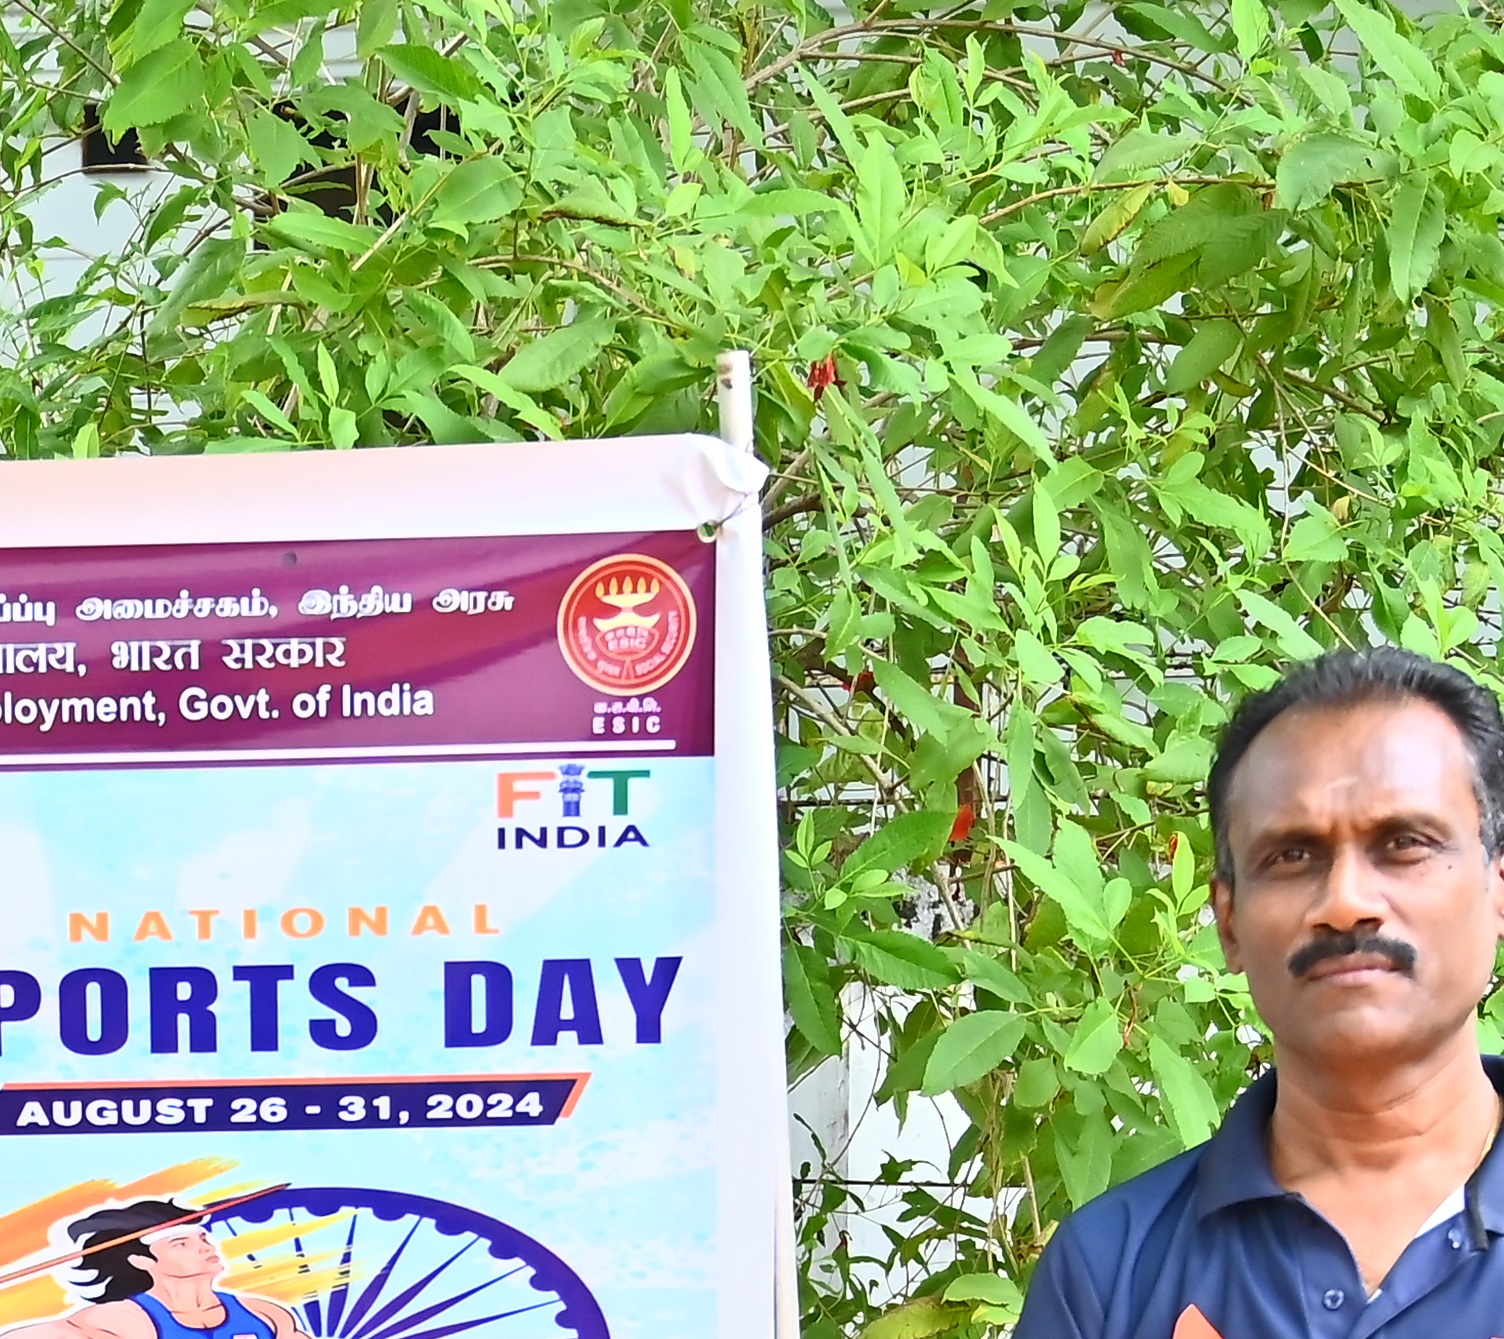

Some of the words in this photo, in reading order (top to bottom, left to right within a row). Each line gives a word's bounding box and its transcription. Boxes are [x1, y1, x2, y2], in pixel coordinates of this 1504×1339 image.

[299, 586, 411, 619] இந்திய
[433, 589, 514, 614] அரசு
[112, 640, 200, 670] भारत
[223, 638, 345, 668] सरकार
[180, 688, 278, 720] Govt.
[293, 685, 331, 717] of
[343, 684, 433, 716] India
[498, 825, 649, 849] INDIA
[70, 905, 497, 941] NATIONAL
[444, 956, 683, 1048] DAY
[17, 1099, 213, 1126] AUGUST
[231, 1098, 287, 1122] 26
[338, 1095, 409, 1124] 31,
[427, 1093, 542, 1118] 2024
